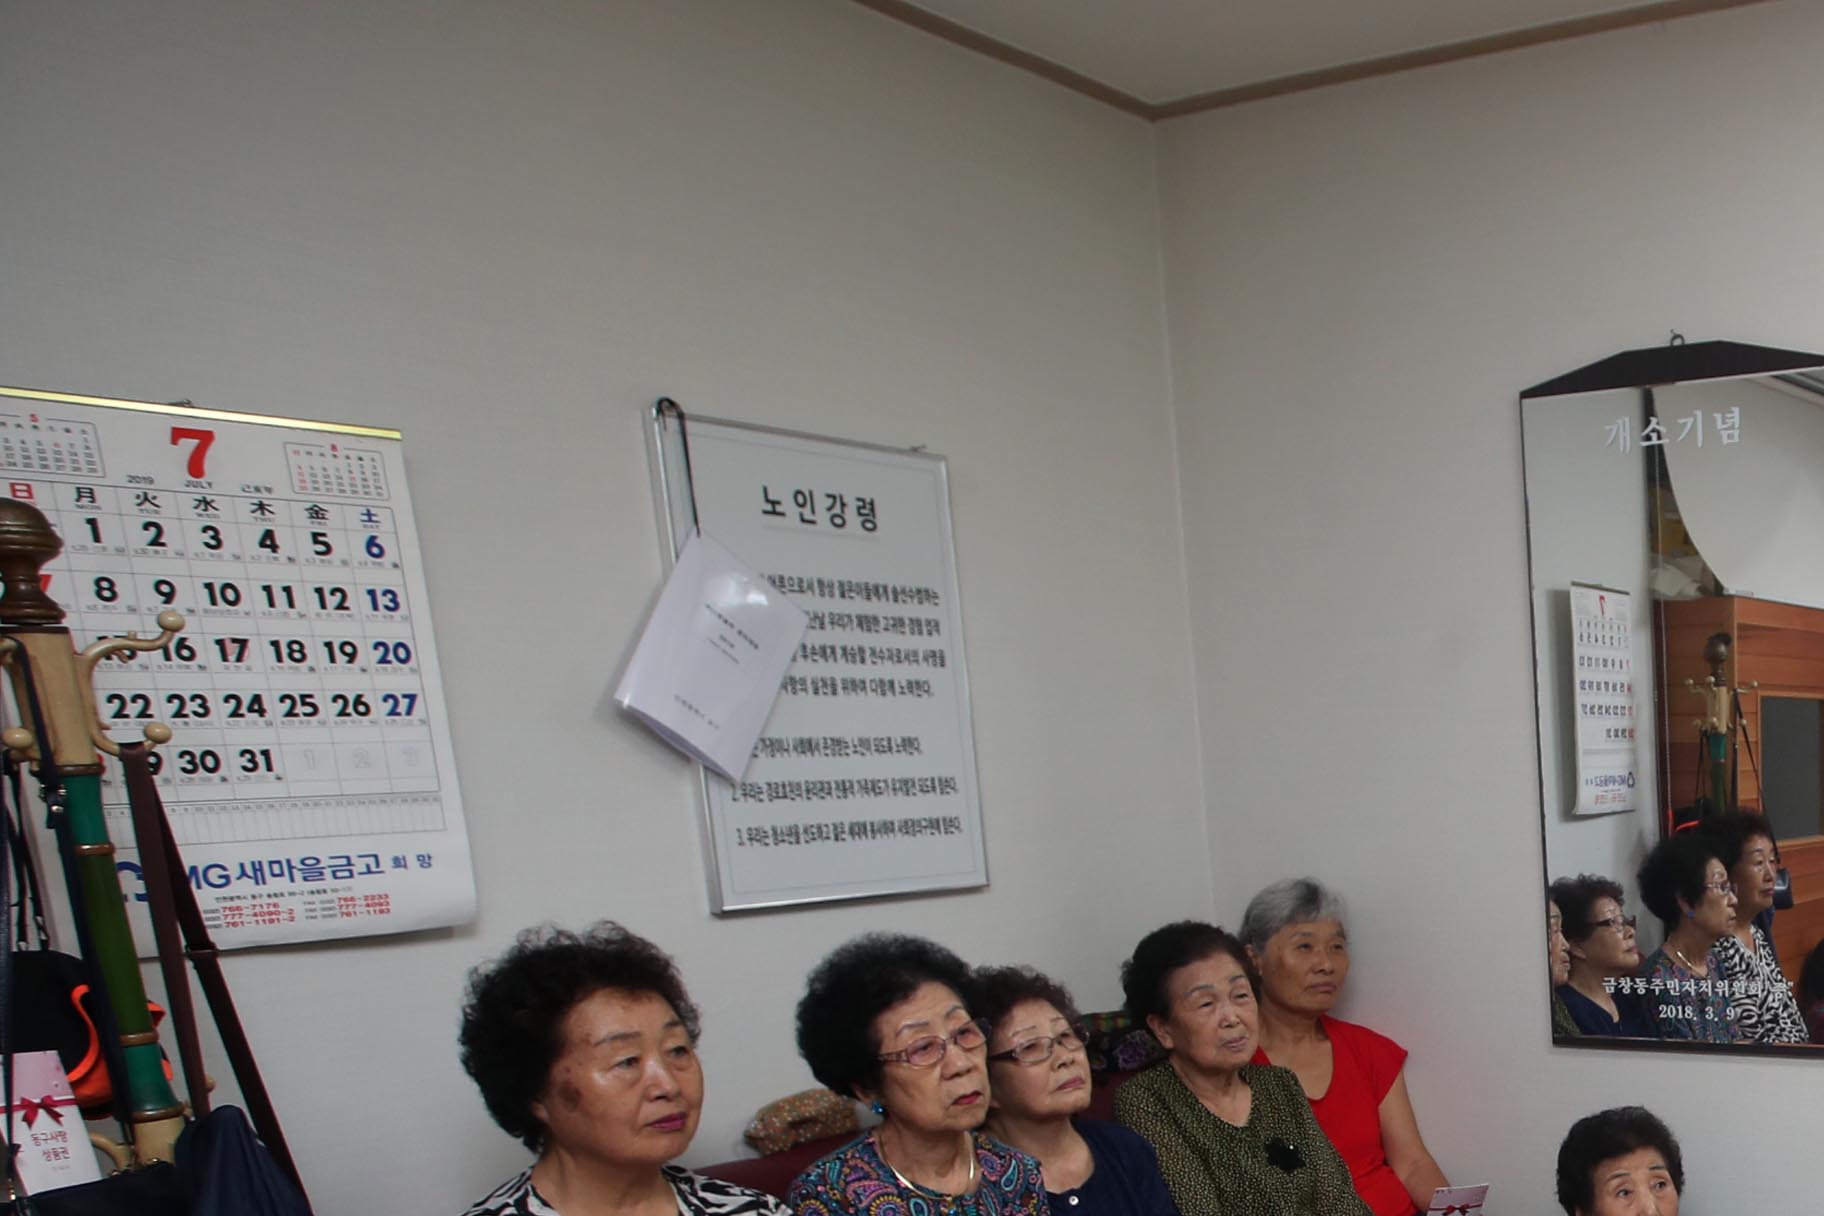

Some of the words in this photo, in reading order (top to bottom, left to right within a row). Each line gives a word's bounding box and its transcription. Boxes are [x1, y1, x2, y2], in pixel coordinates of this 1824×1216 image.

[1605, 406, 1740, 454] 개소기념
[170, 426, 215, 479] 7
[127, 475, 155, 485] 2019
[184, 480, 213, 489] JULY
[9, 482, 34, 500] 日
[75, 487, 96, 503] 月
[135, 491, 161, 508] 火
[193, 496, 220, 512] 水
[250, 501, 275, 516] 木
[304, 504, 329, 520] 金
[360, 508, 381, 523] 土
[761, 485, 879, 532] 노인강령
[85, 517, 102, 544] 1
[142, 521, 167, 547] 2
[201, 525, 224, 551] 3
[258, 529, 280, 554] 4
[310, 531, 333, 556] 5
[365, 535, 386, 559] 6
[94, 576, 119, 603] 8
[153, 579, 177, 605] 9
[203, 581, 242, 607] 10
[261, 584, 296, 609] 11
[314, 586, 351, 611] 12
[366, 588, 401, 613] 13
[162, 637, 197, 662] 16
[215, 638, 249, 663] 17
[269, 640, 307, 663] 18
[323, 640, 358, 664] 19
[373, 641, 411, 665] 20
[106, 693, 154, 718] 22
[166, 693, 210, 718] 23
[223, 693, 267, 718] 24
[279, 694, 319, 717] 25
[332, 694, 371, 717] 26
[382, 694, 418, 716] 27
[178, 749, 221, 775] 30
[239, 749, 274, 773] 31
[188, 853, 385, 889] MG새마을금고
[1602, 976, 1763, 998] 금창동주민자치위원회
[1659, 1004, 1697, 1021] 2018.
[1705, 1006, 1719, 1022] 3.
[30, 1130, 67, 1147] 동구사랑
